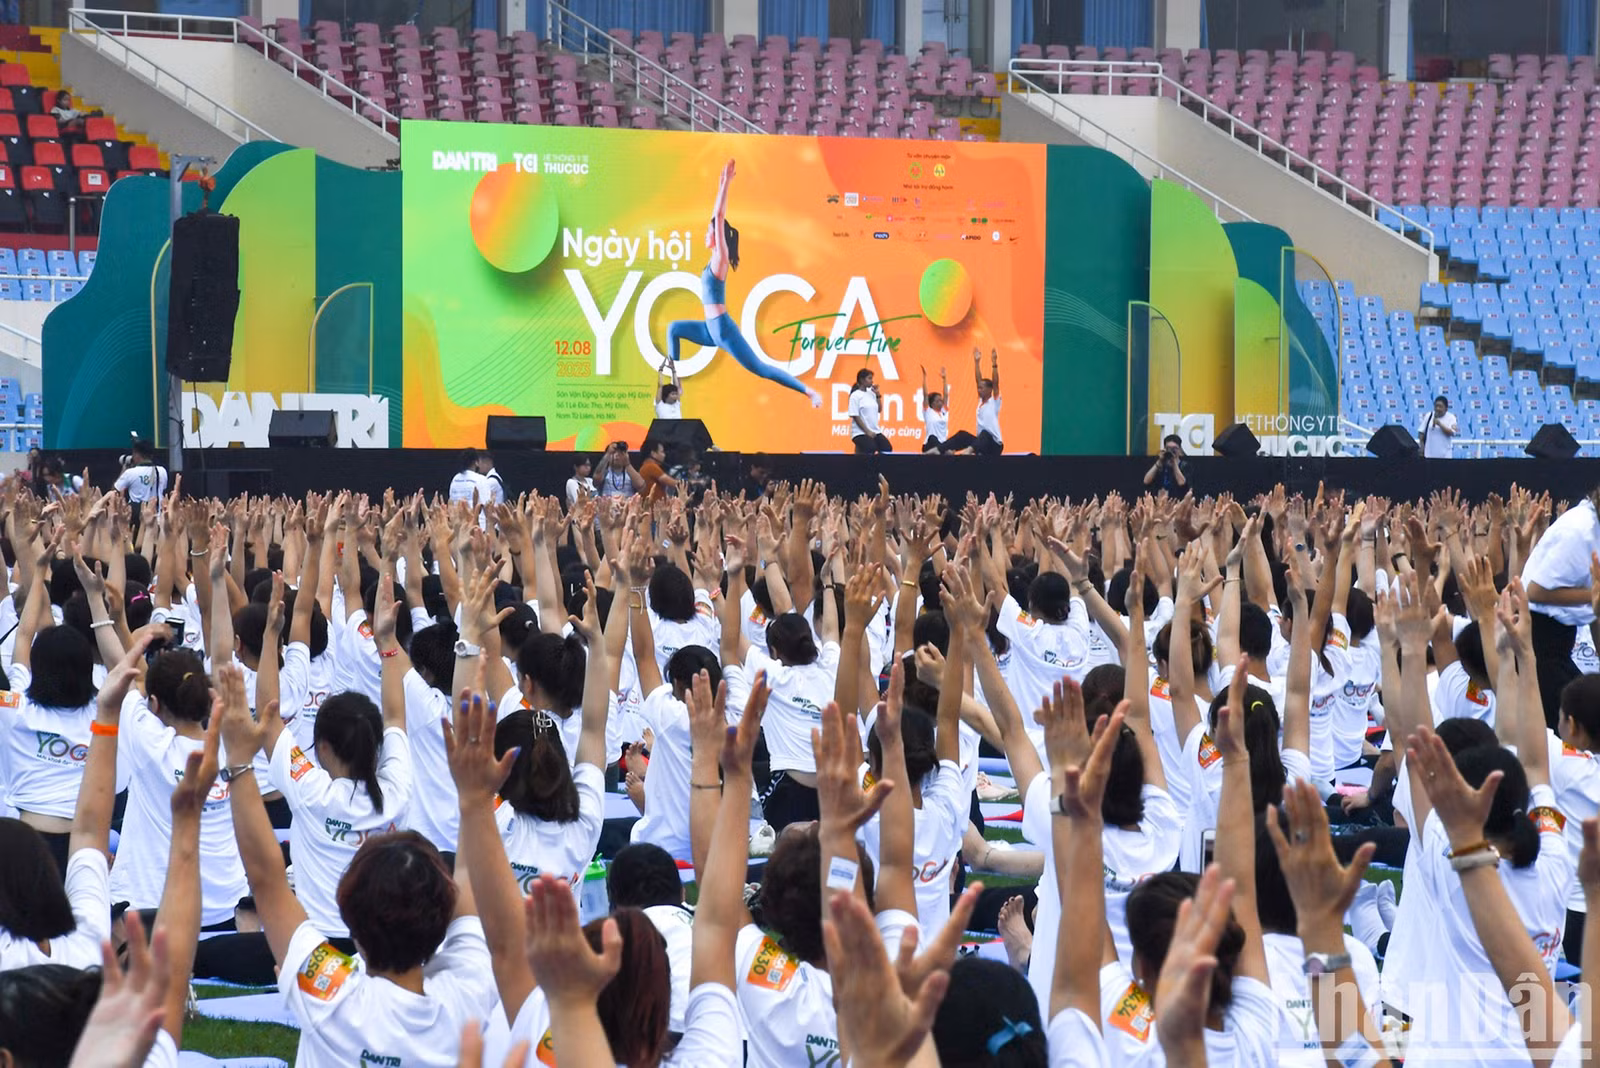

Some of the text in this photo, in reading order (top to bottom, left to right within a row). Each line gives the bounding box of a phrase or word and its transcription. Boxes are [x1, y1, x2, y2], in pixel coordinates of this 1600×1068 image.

[563, 227, 692, 270] Ngày hội
[563, 269, 900, 380] YOGA
[555, 341, 591, 355] 12.08
[773, 313, 922, 368] Forever Fine
[556, 361, 591, 378] 2023
[831, 383, 903, 421] Dn
[36, 731, 90, 761] YOG
[1286, 999, 1312, 1009] DANT
[805, 1034, 838, 1050] DANT
